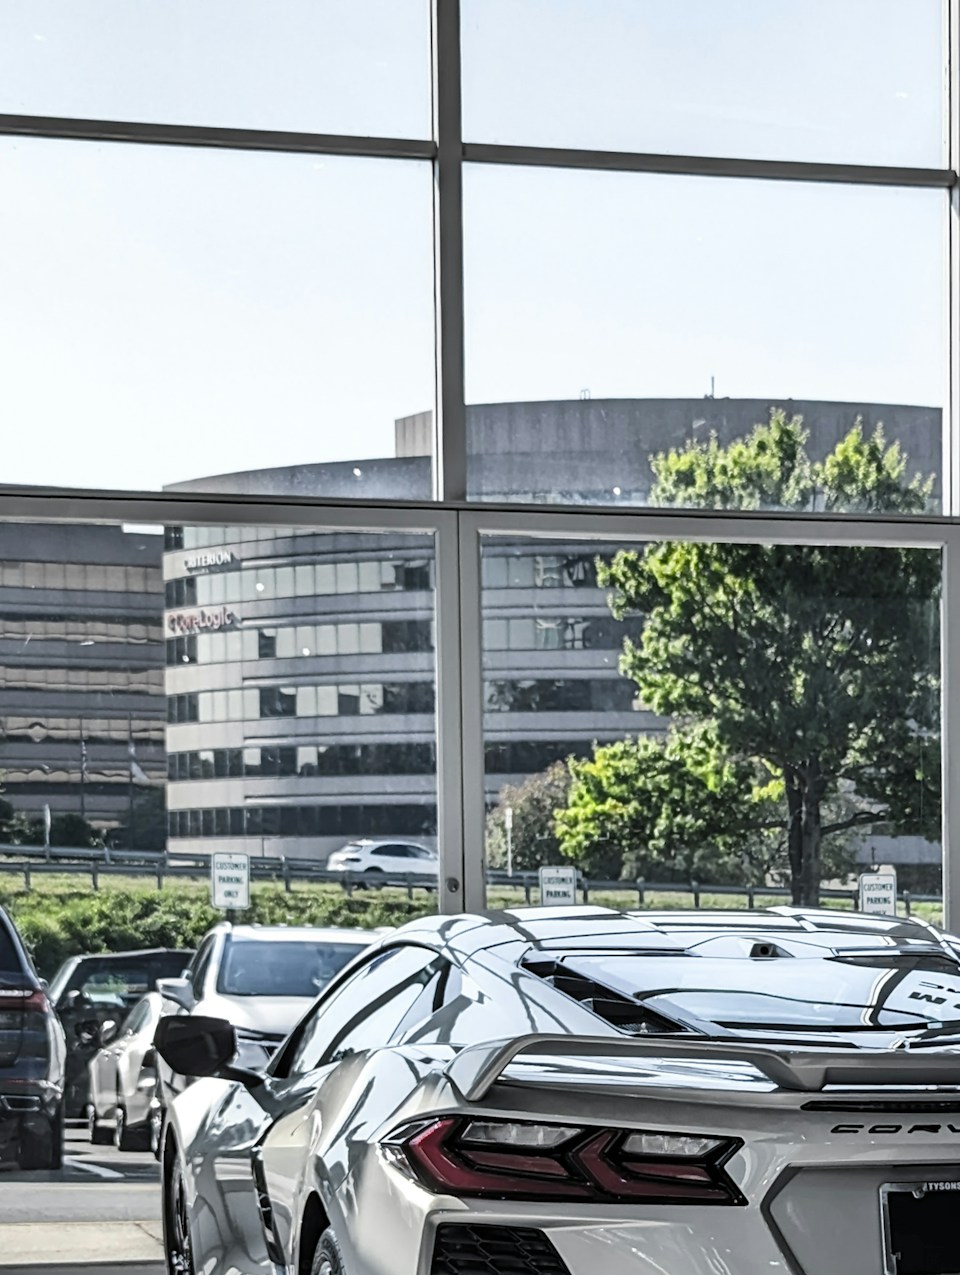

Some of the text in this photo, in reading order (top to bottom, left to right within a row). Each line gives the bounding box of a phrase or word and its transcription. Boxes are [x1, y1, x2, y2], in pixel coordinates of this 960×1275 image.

[215, 862, 247, 870] CUSTOMER
[218, 875, 244, 884] PARKING
[543, 876, 573, 884] CUSTOMER
[863, 883, 893, 891] CUSTOMER
[546, 890, 571, 898] PARKING
[866, 896, 891, 904] PARKING
